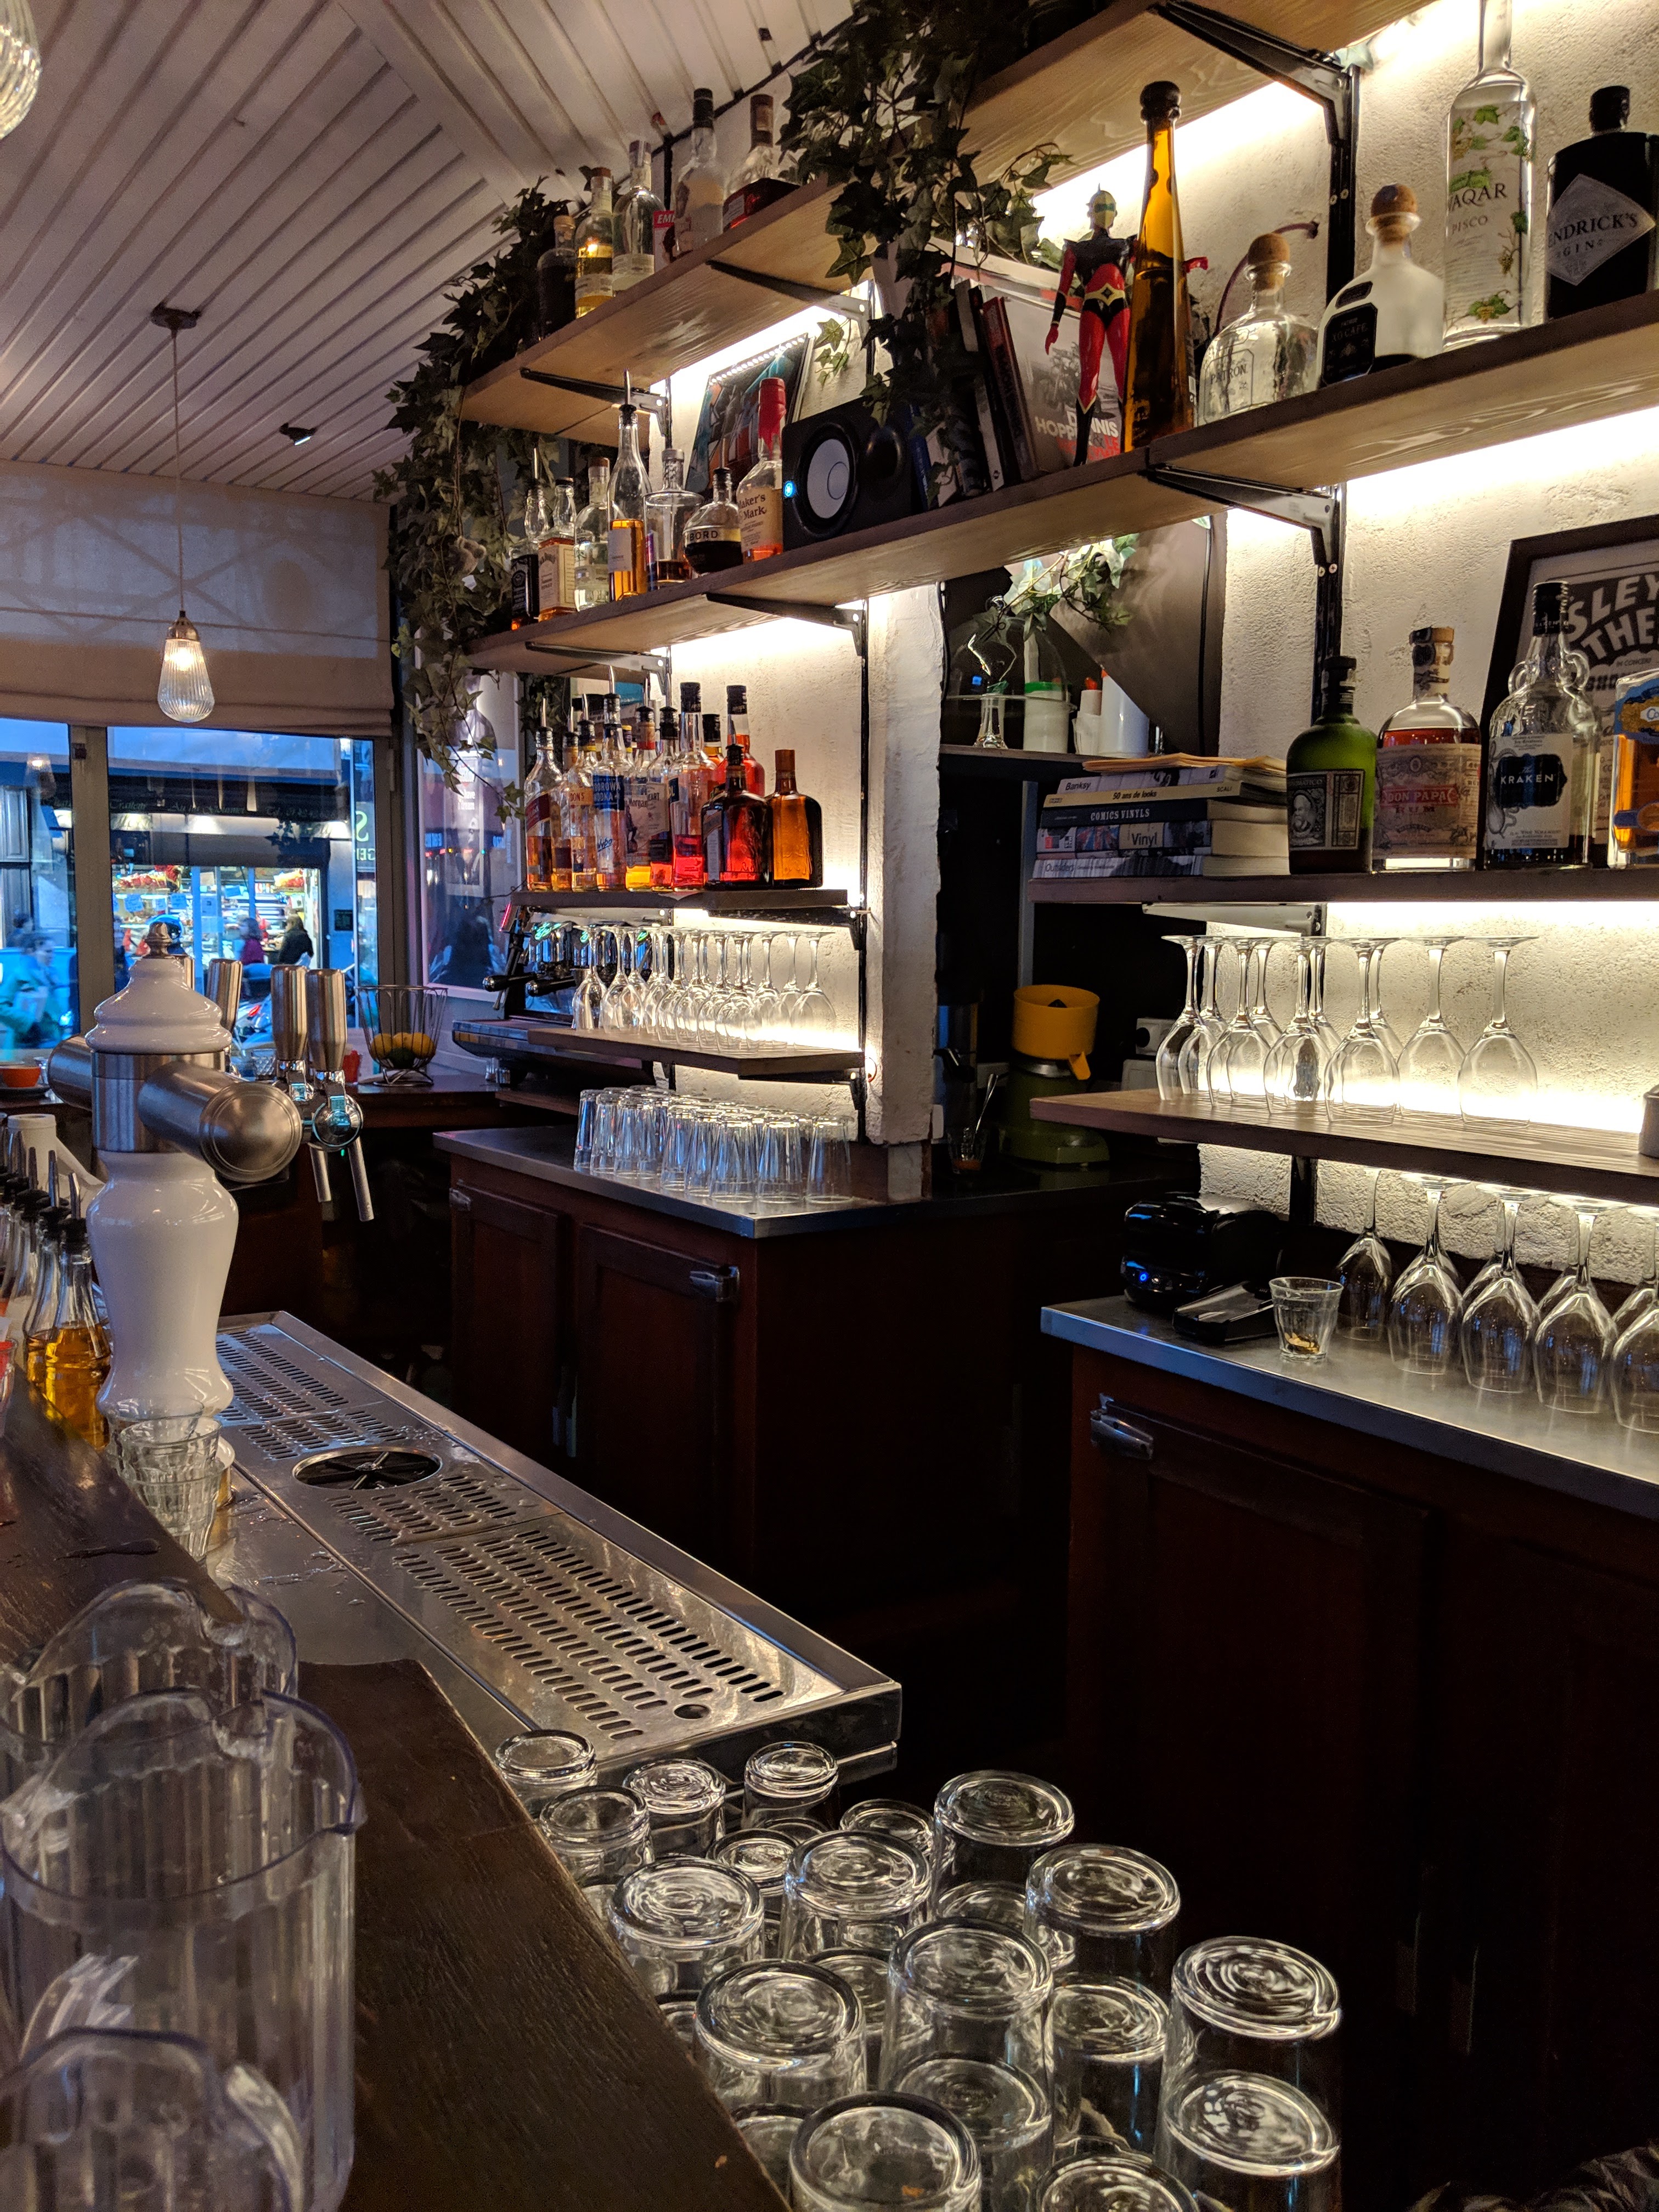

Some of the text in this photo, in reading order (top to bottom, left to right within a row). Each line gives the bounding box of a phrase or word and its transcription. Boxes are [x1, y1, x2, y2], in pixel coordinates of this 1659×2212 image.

[1452, 215, 1488, 234] PISCO
[1548, 212, 1638, 247] ENDRICK'S
[1035, 415, 1091, 443] HOPP
[743, 506, 767, 520] Mark
[688, 530, 718, 541] BORD
[1065, 781, 1092, 791] Banksy
[1500, 774, 1554, 785] KRAKEN
[1388, 791, 1447, 803] DON PAPA
[1090, 810, 1119, 821] COMICS
[1121, 808, 1150, 819] VINYLS
[1395, 805, 1435, 814] RUM
[1132, 833, 1158, 847] Vinyl
